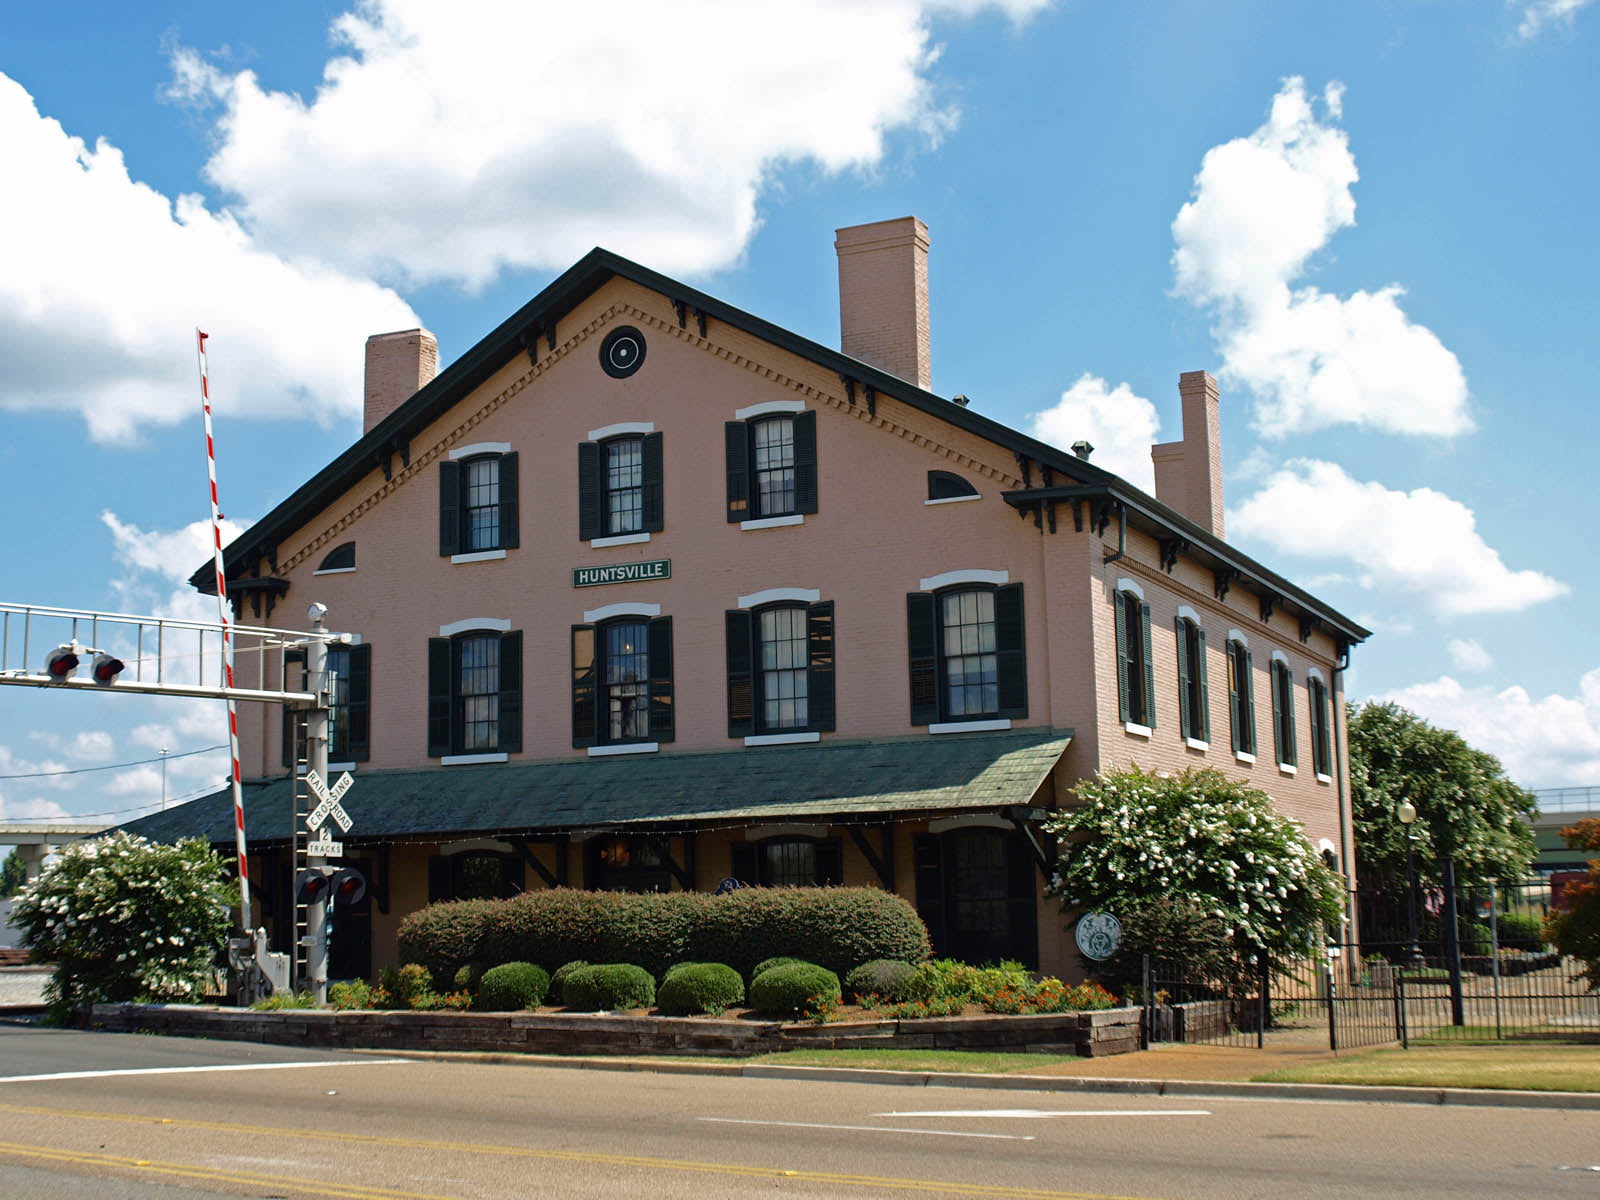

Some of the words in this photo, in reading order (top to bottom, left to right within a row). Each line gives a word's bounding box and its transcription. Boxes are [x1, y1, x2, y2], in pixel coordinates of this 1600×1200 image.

[579, 563, 663, 584] HUNTSVILLE
[308, 773, 326, 797] RAIL
[310, 777, 350, 826] CROSSING
[322, 832, 328, 841] 2
[310, 845, 341, 854] TRACKS
